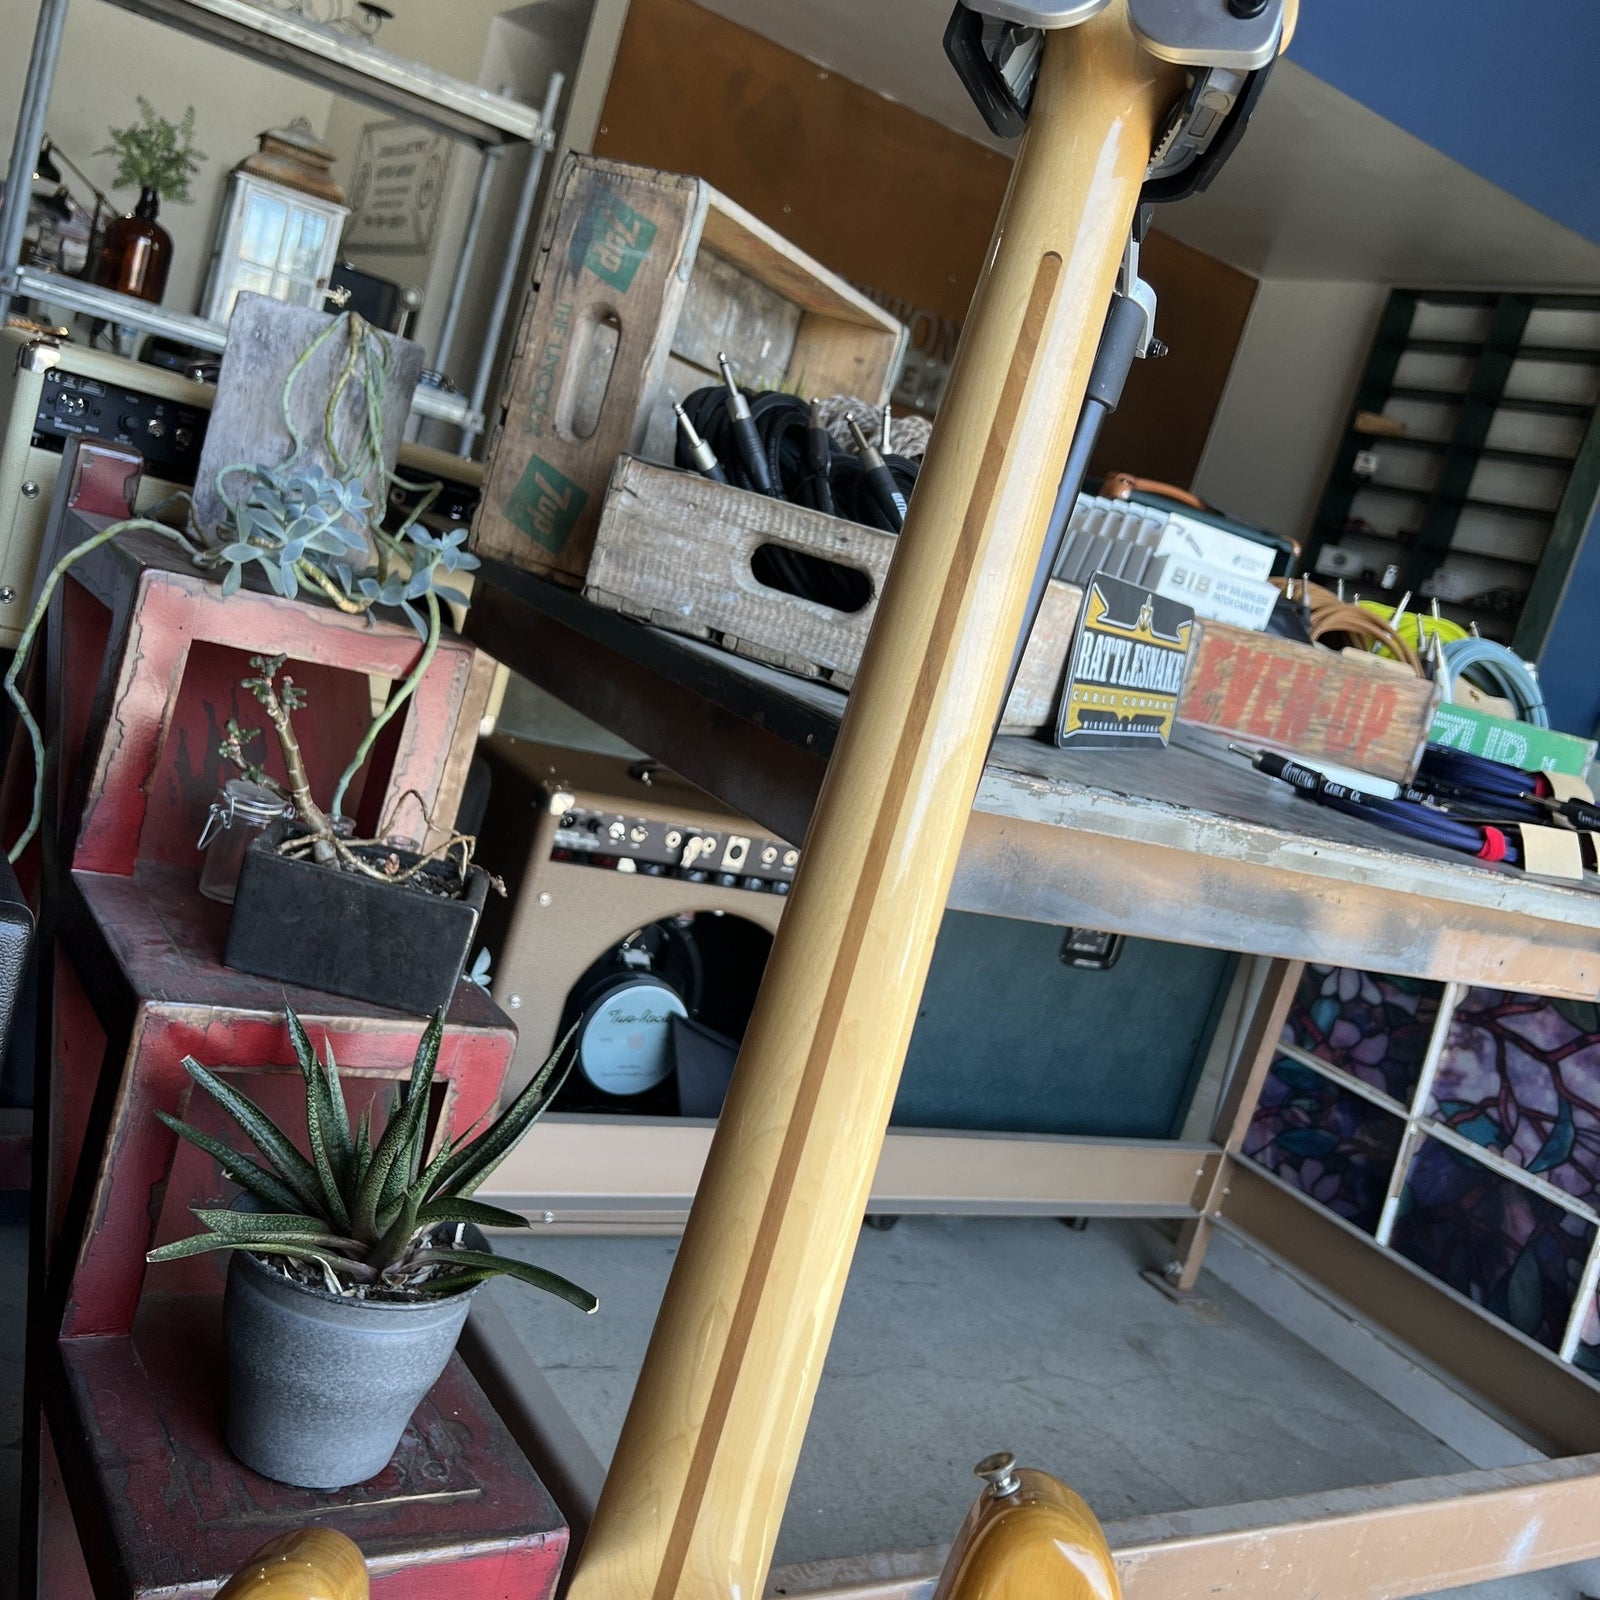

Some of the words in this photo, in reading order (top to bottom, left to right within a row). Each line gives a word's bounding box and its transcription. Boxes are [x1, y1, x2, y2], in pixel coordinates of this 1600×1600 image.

[546, 302, 573, 337] THE
[524, 342, 562, 438] UNCOLA
[1074, 631, 1186, 694] RATTLESNAKE
[1073, 689, 1116, 706] CABLE
[1122, 694, 1175, 711] COMPANY
[1083, 720, 1124, 732] MISSOULA
[1126, 722, 1159, 733] MONTANA
